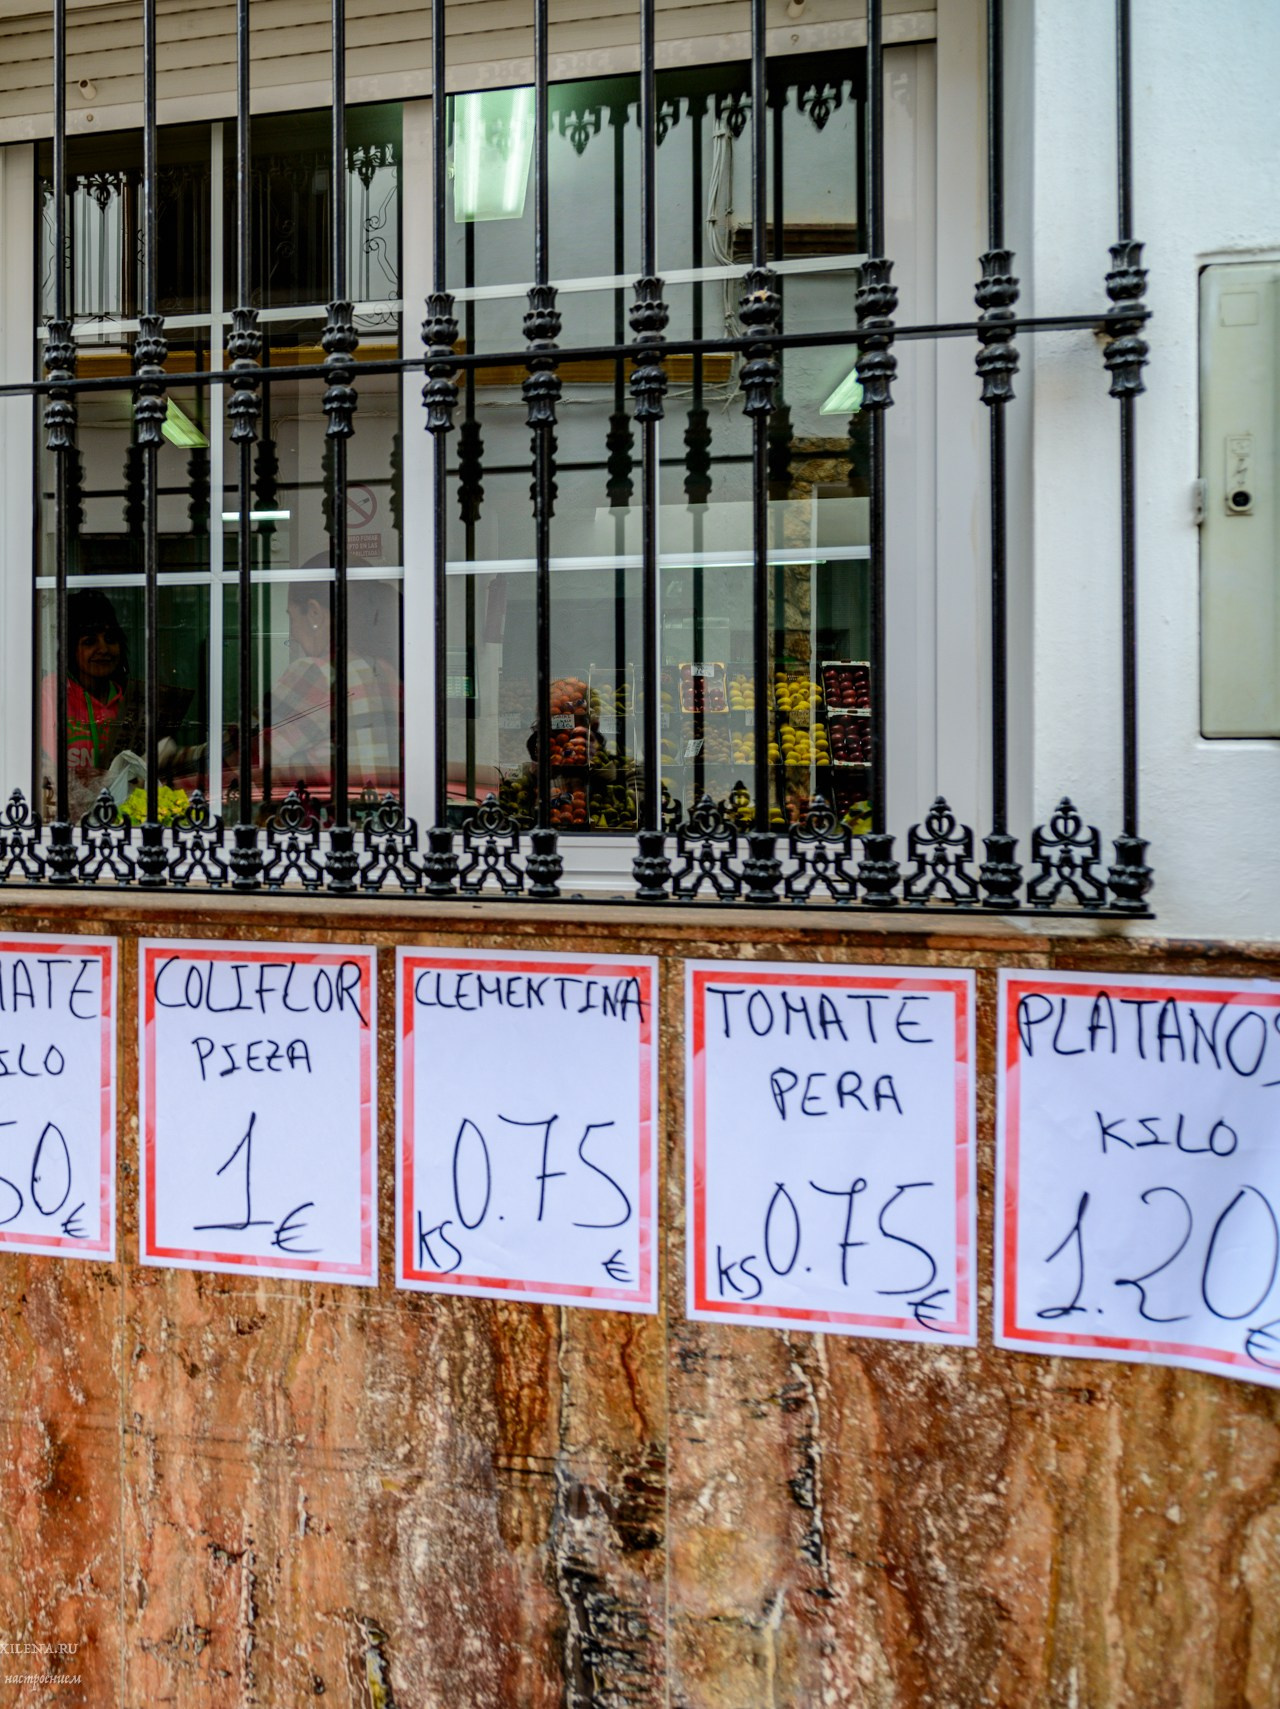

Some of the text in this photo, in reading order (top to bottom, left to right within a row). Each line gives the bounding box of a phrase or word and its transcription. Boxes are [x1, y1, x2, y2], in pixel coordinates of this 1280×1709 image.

[153, 955, 369, 1027] COLIFLOR
[414, 970, 645, 1024] CLEMENTINA
[706, 986, 934, 1044] TOMATE
[191, 1036, 312, 1081] PIEZA
[770, 1067, 903, 1121] PERA
[1096, 1111, 1238, 1157] KILO
